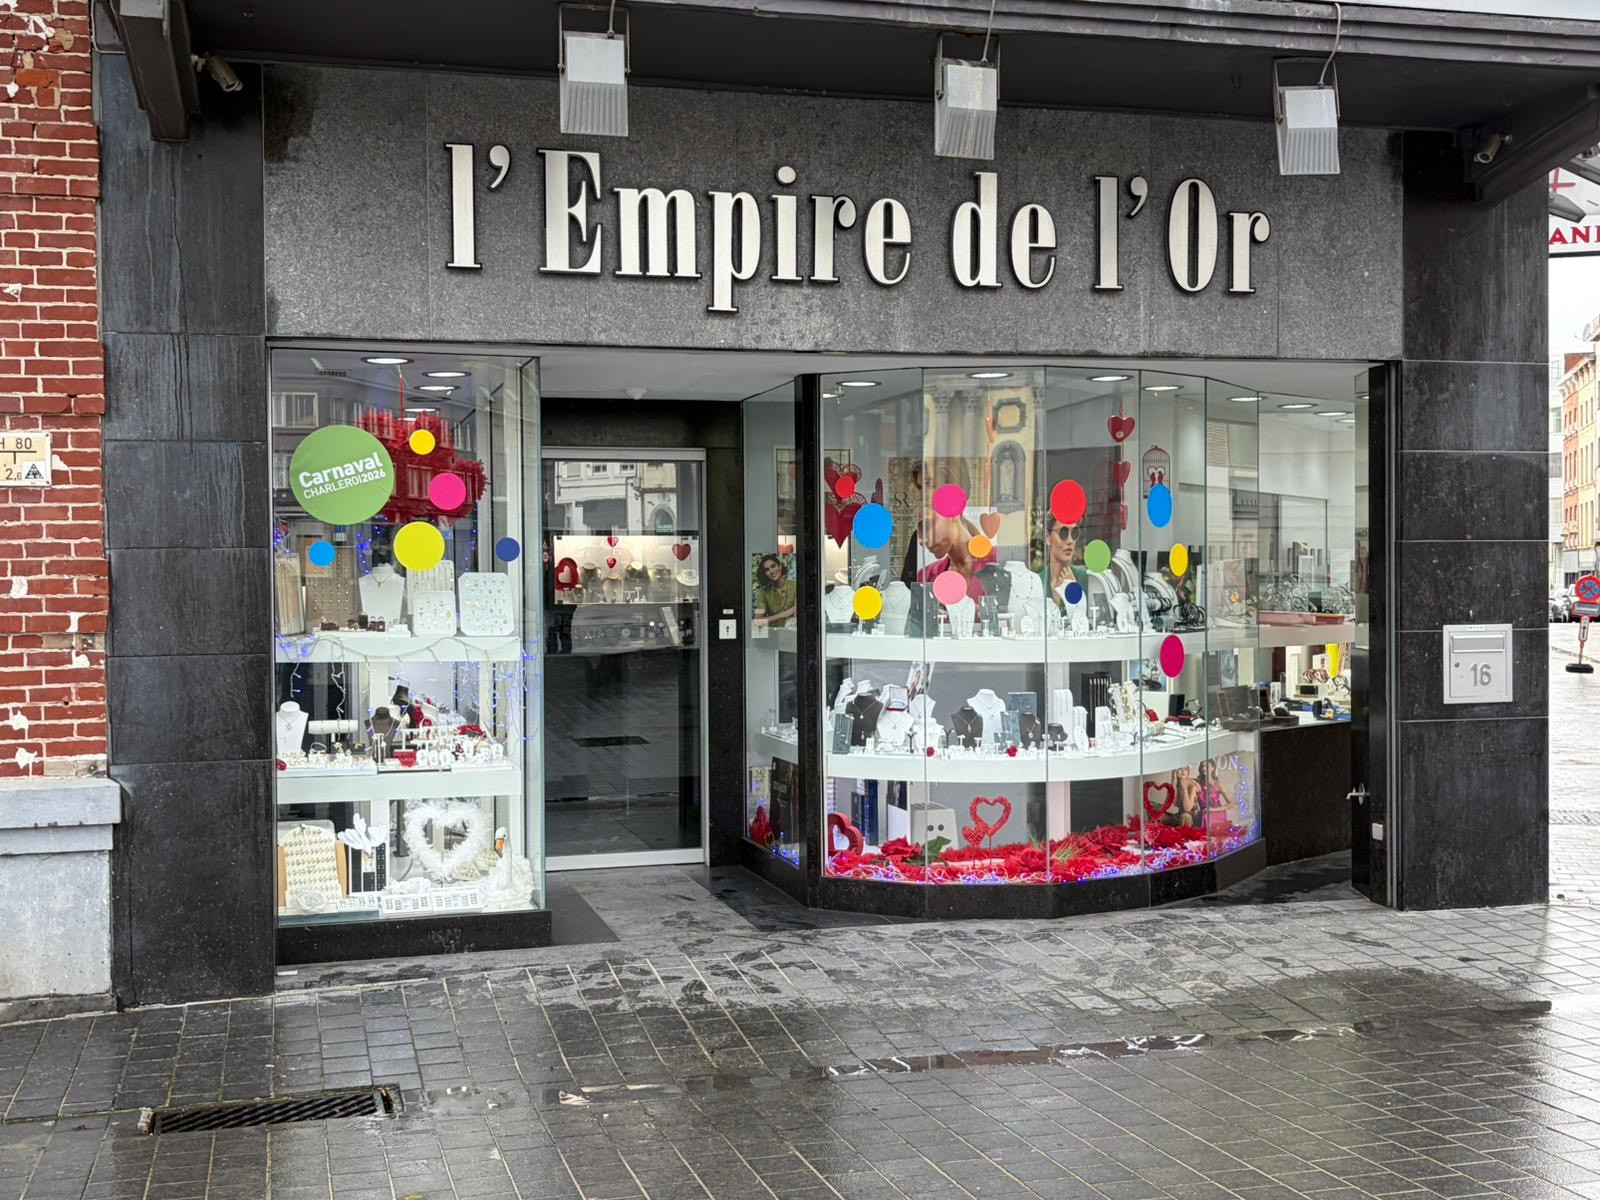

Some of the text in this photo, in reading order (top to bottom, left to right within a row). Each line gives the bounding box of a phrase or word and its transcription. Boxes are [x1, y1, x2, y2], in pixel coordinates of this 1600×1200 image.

[953, 172, 1058, 289] de
[1094, 175, 1271, 292] l'Or
[15, 437, 32, 449] 80
[299, 451, 384, 488] Carnaval
[1470, 663, 1492, 687] 16
